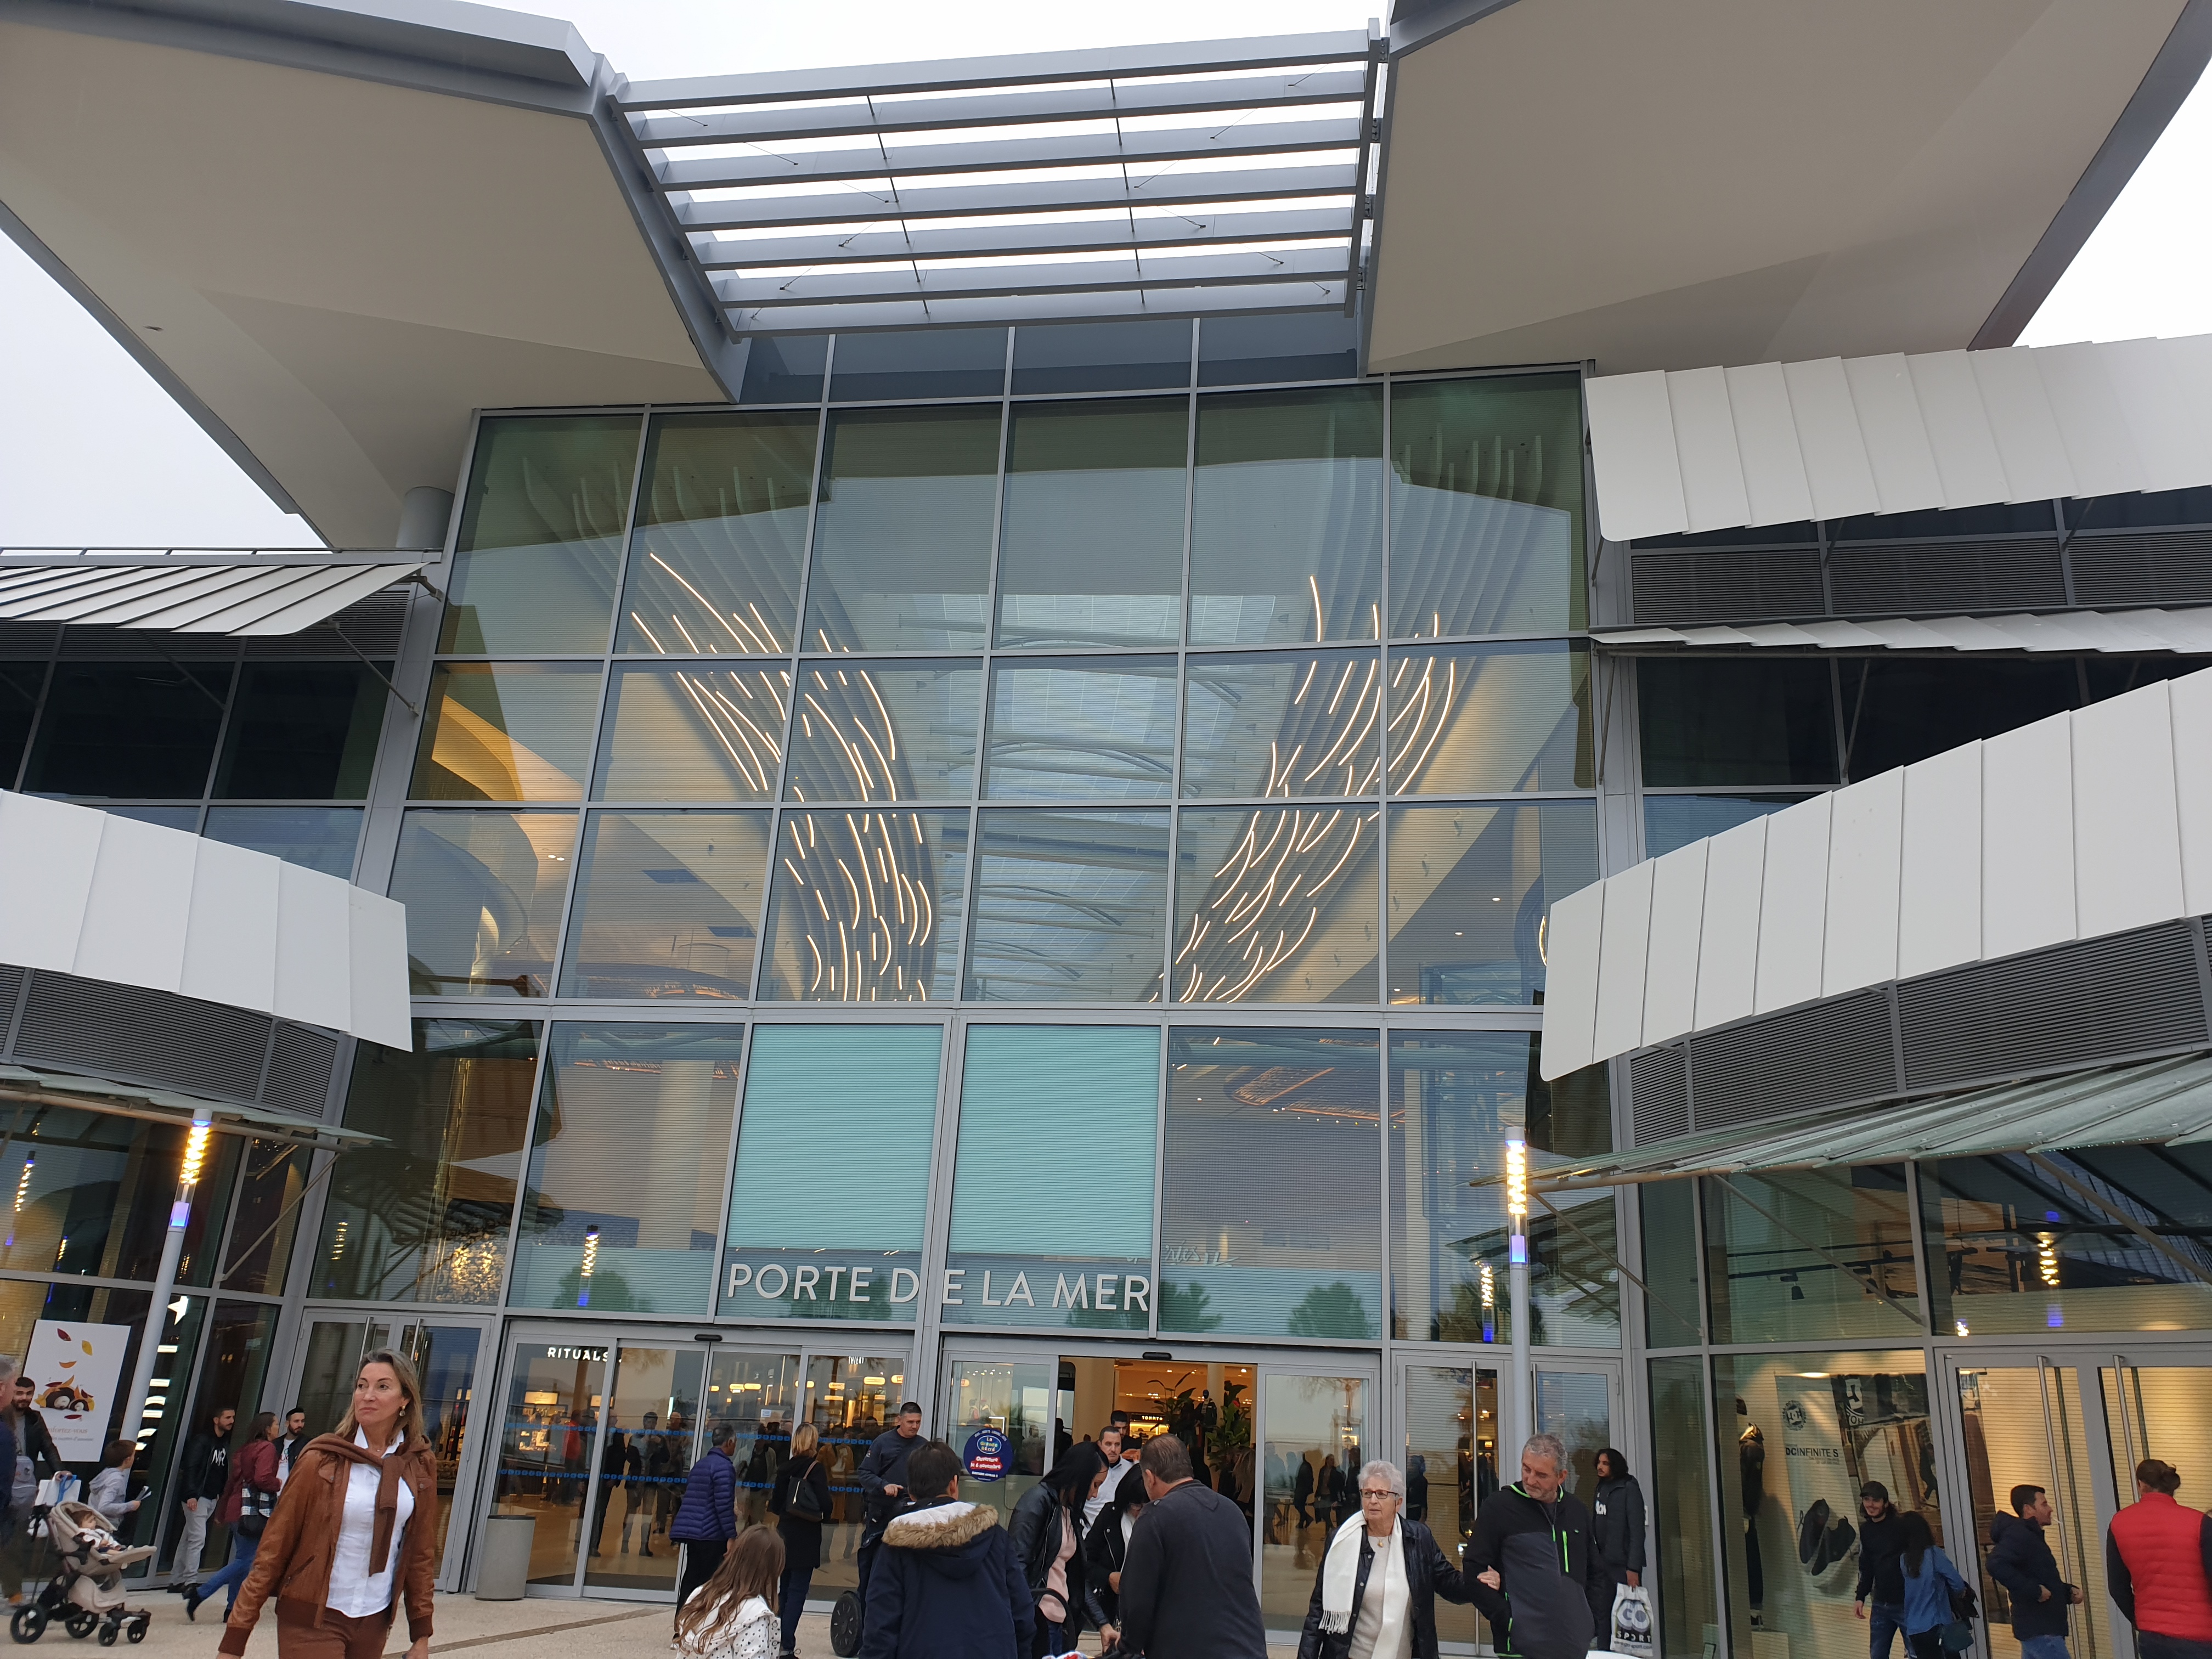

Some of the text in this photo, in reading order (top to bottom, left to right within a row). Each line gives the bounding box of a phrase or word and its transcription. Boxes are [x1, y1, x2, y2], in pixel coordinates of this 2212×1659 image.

[728, 1263, 1150, 1312] PORTE DE LA MER
[1833, 1449, 1838, 1458] S
